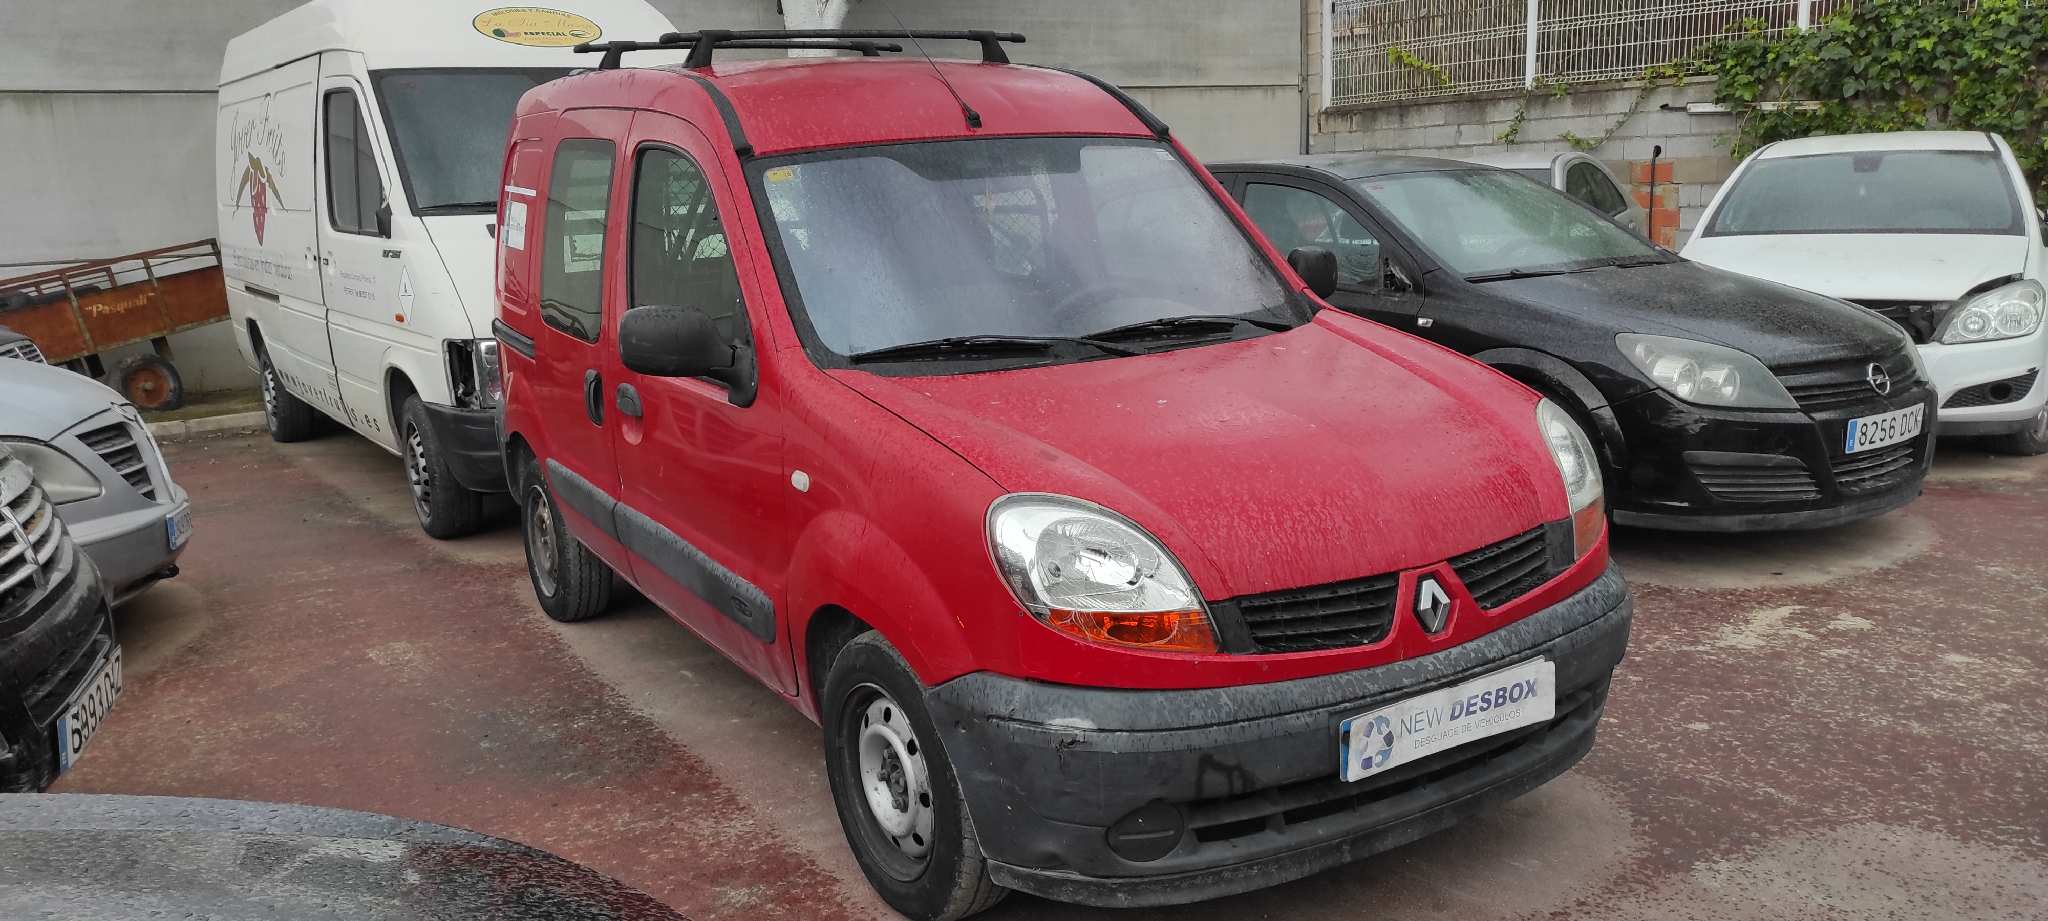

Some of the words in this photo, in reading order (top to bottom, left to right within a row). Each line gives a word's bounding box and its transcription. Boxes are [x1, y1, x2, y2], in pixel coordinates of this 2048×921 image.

[1859, 416, 1897, 446] 8256
[1900, 407, 1922, 437] DCK
[1399, 706, 1444, 738] NEW
[1449, 678, 1538, 721] DESBOX
[1461, 722, 1473, 735] DE
